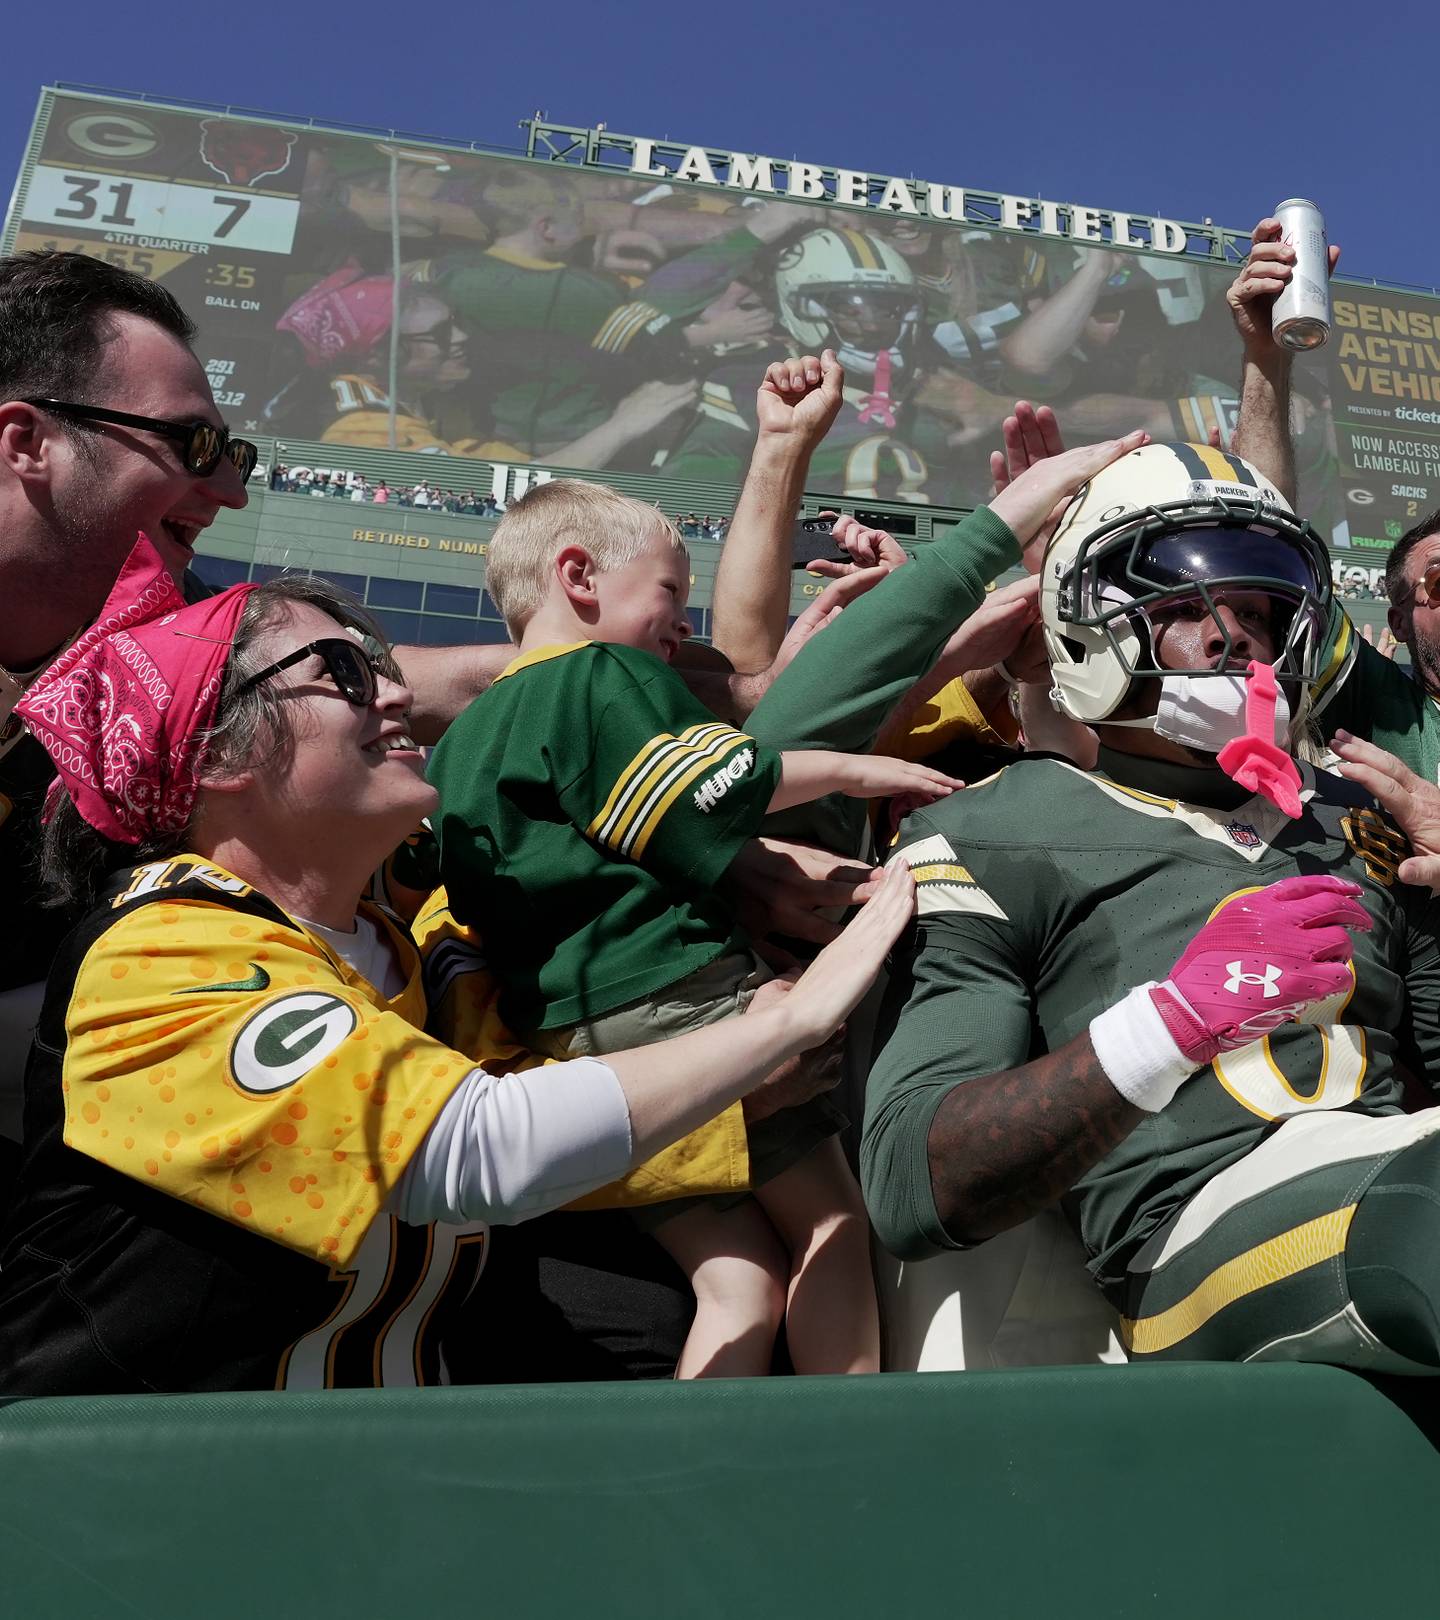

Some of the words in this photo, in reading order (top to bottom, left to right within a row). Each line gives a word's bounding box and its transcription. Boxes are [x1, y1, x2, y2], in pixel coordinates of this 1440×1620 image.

[54, 175, 137, 227] 31
[631, 137, 967, 222] LAMBEAU
[1001, 194, 1188, 254] FIELD
[212, 195, 251, 239] 7
[104, 231, 134, 246] 4TH
[137, 235, 209, 255] QUARTER
[205, 263, 257, 289] :35
[205, 295, 237, 308] BALL
[241, 299, 260, 312] ON
[205, 359, 236, 375] 291
[1347, 405, 1382, 416] PRESENTED
[1382, 409, 1391, 417] BY
[1351, 434, 1383, 452] NOW
[1353, 453, 1420, 476] LAMBEAU
[1215, 486, 1249, 497] PACKERS
[1391, 484, 1428, 499] SACKS
[1407, 501, 1417, 517] 2
[352, 529, 430, 549] RETIRED
[694, 747, 755, 814] HUTCH
